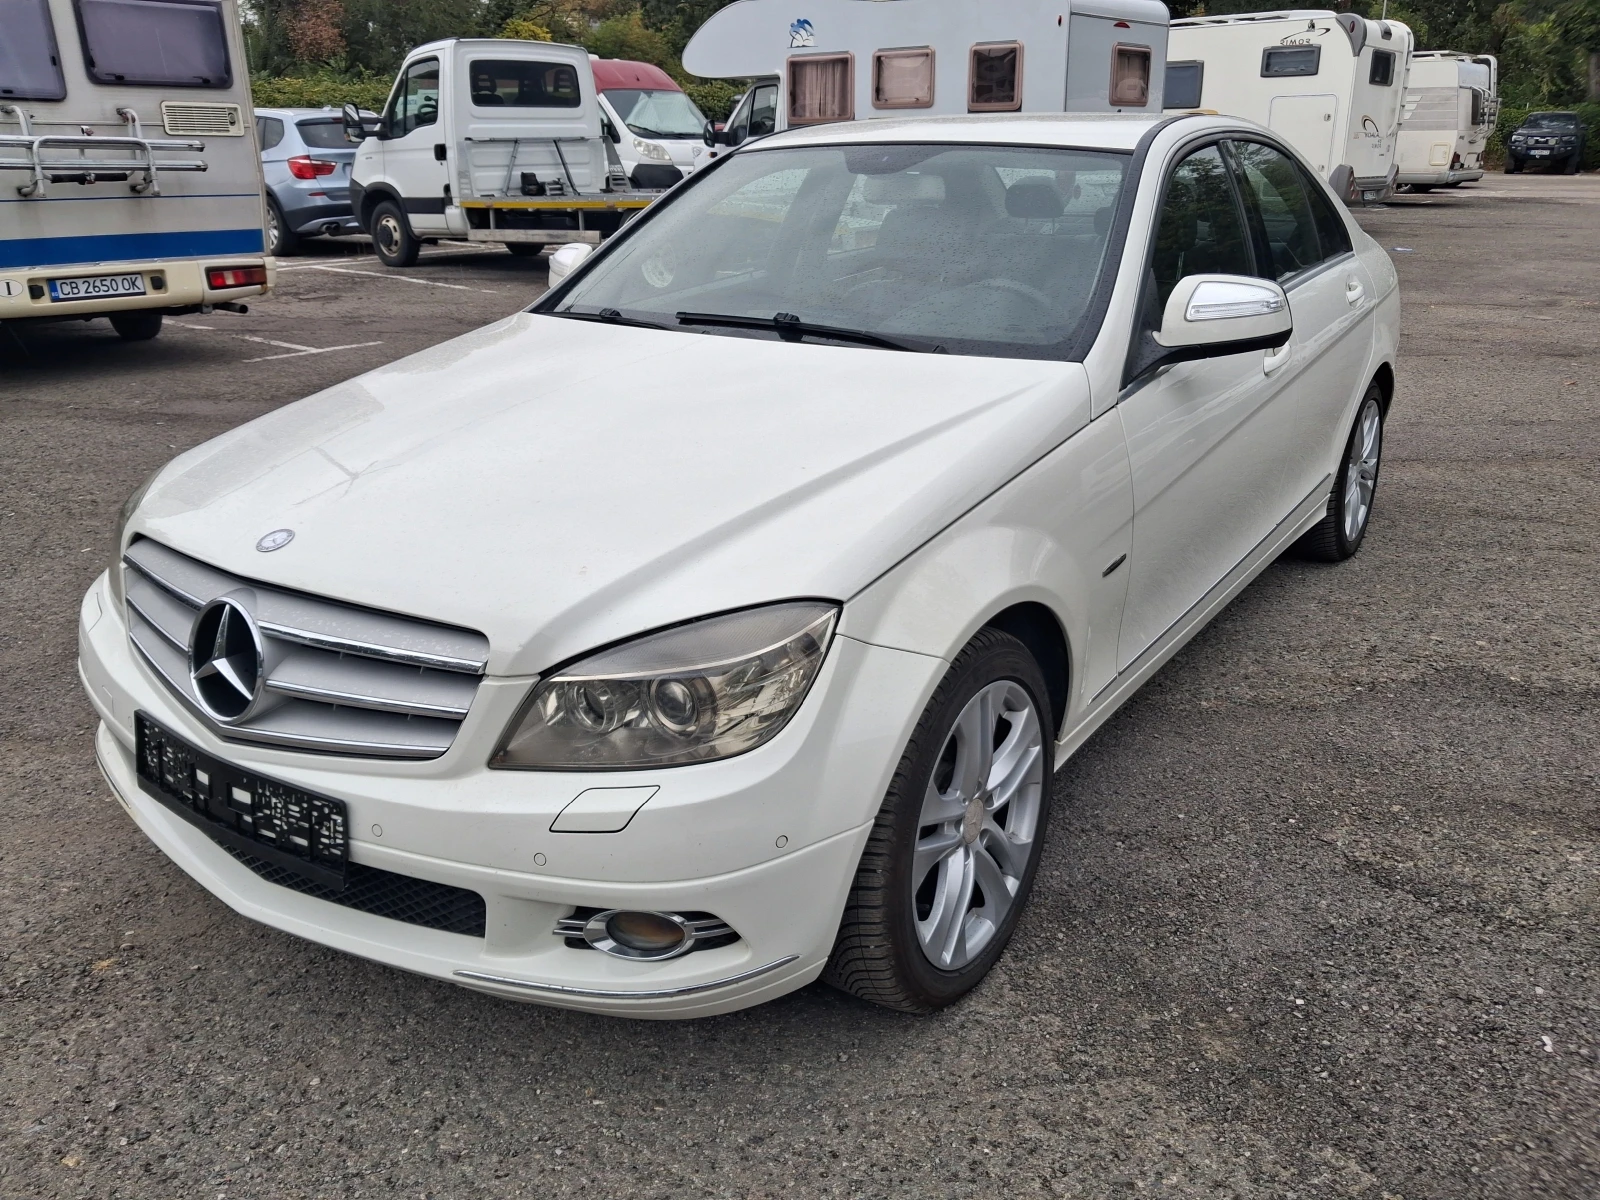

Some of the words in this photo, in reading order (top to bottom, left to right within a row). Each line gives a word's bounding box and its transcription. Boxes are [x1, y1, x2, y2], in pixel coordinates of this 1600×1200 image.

[6, 281, 12, 296] I
[60, 280, 80, 296] CB
[82, 278, 119, 295] 2650
[121, 276, 142, 291] OK
